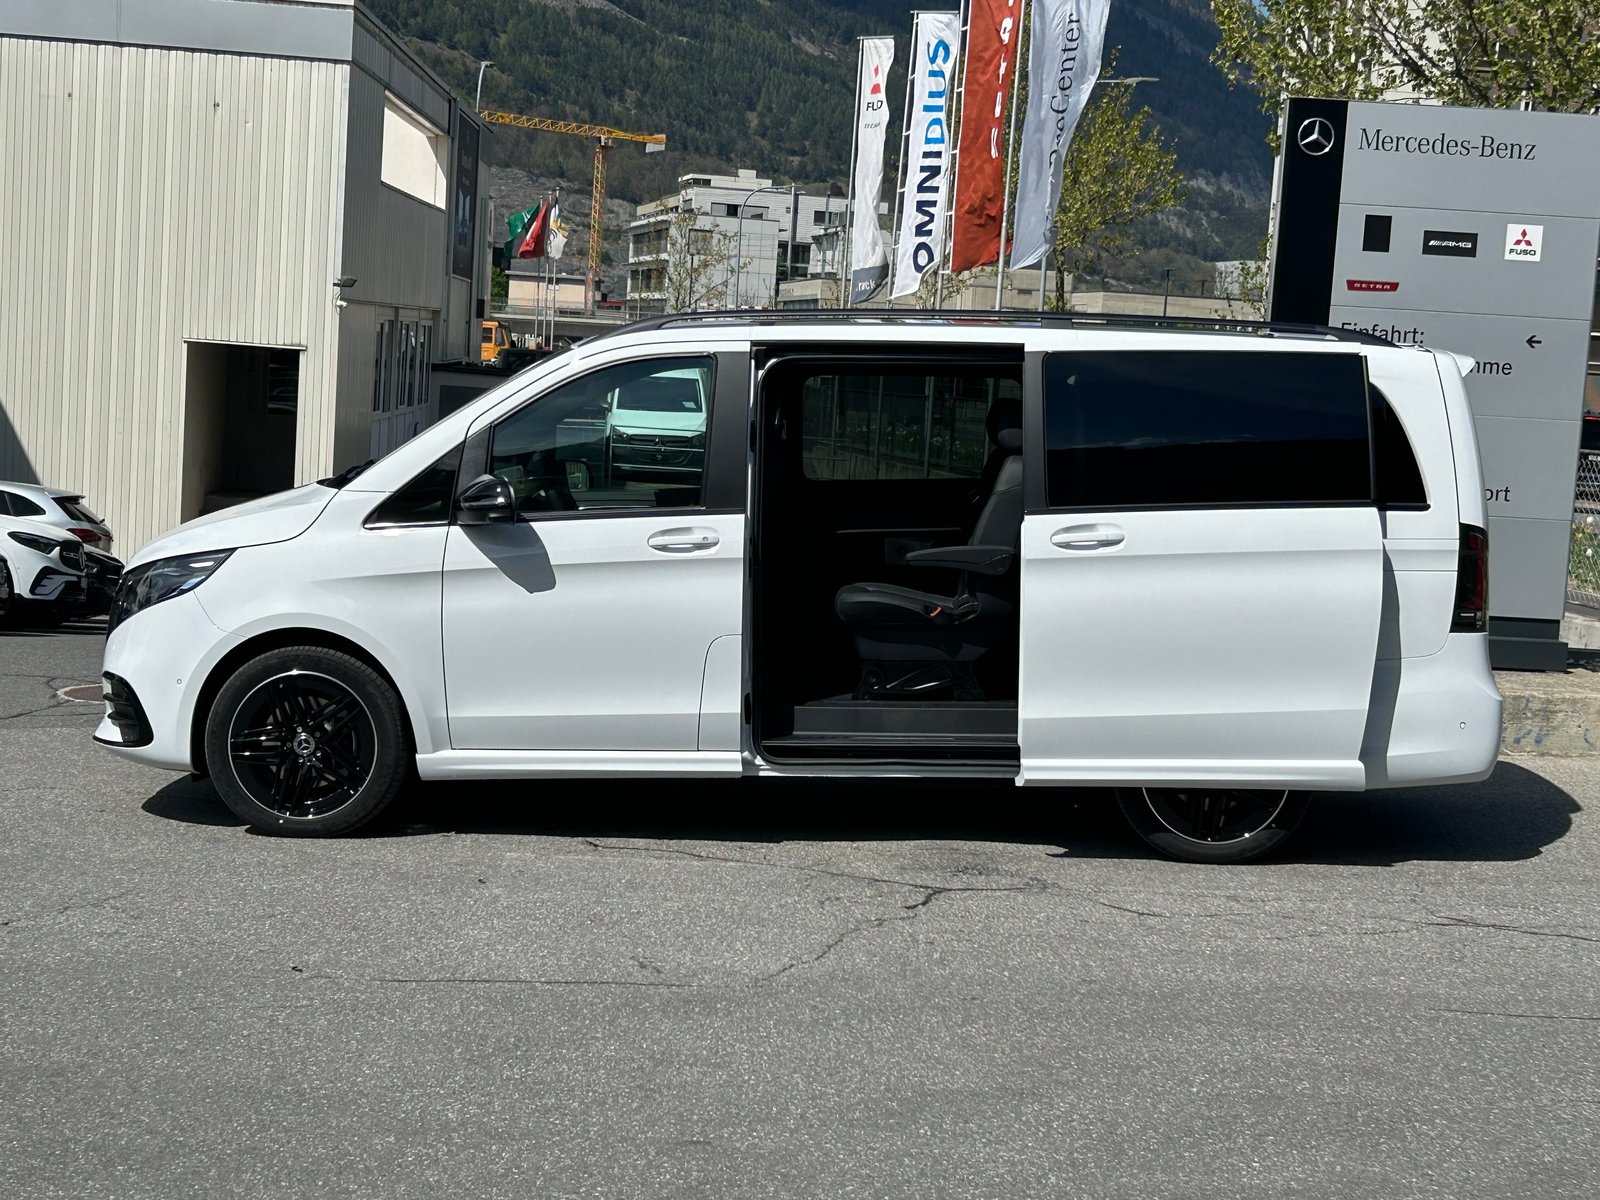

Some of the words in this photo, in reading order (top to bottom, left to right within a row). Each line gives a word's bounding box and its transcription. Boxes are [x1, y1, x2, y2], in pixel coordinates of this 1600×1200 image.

[912, 39, 951, 274] OMNIDIUS
[1358, 128, 1538, 161] Mercedes-Benz
[1508, 248, 1537, 256] FUSO
